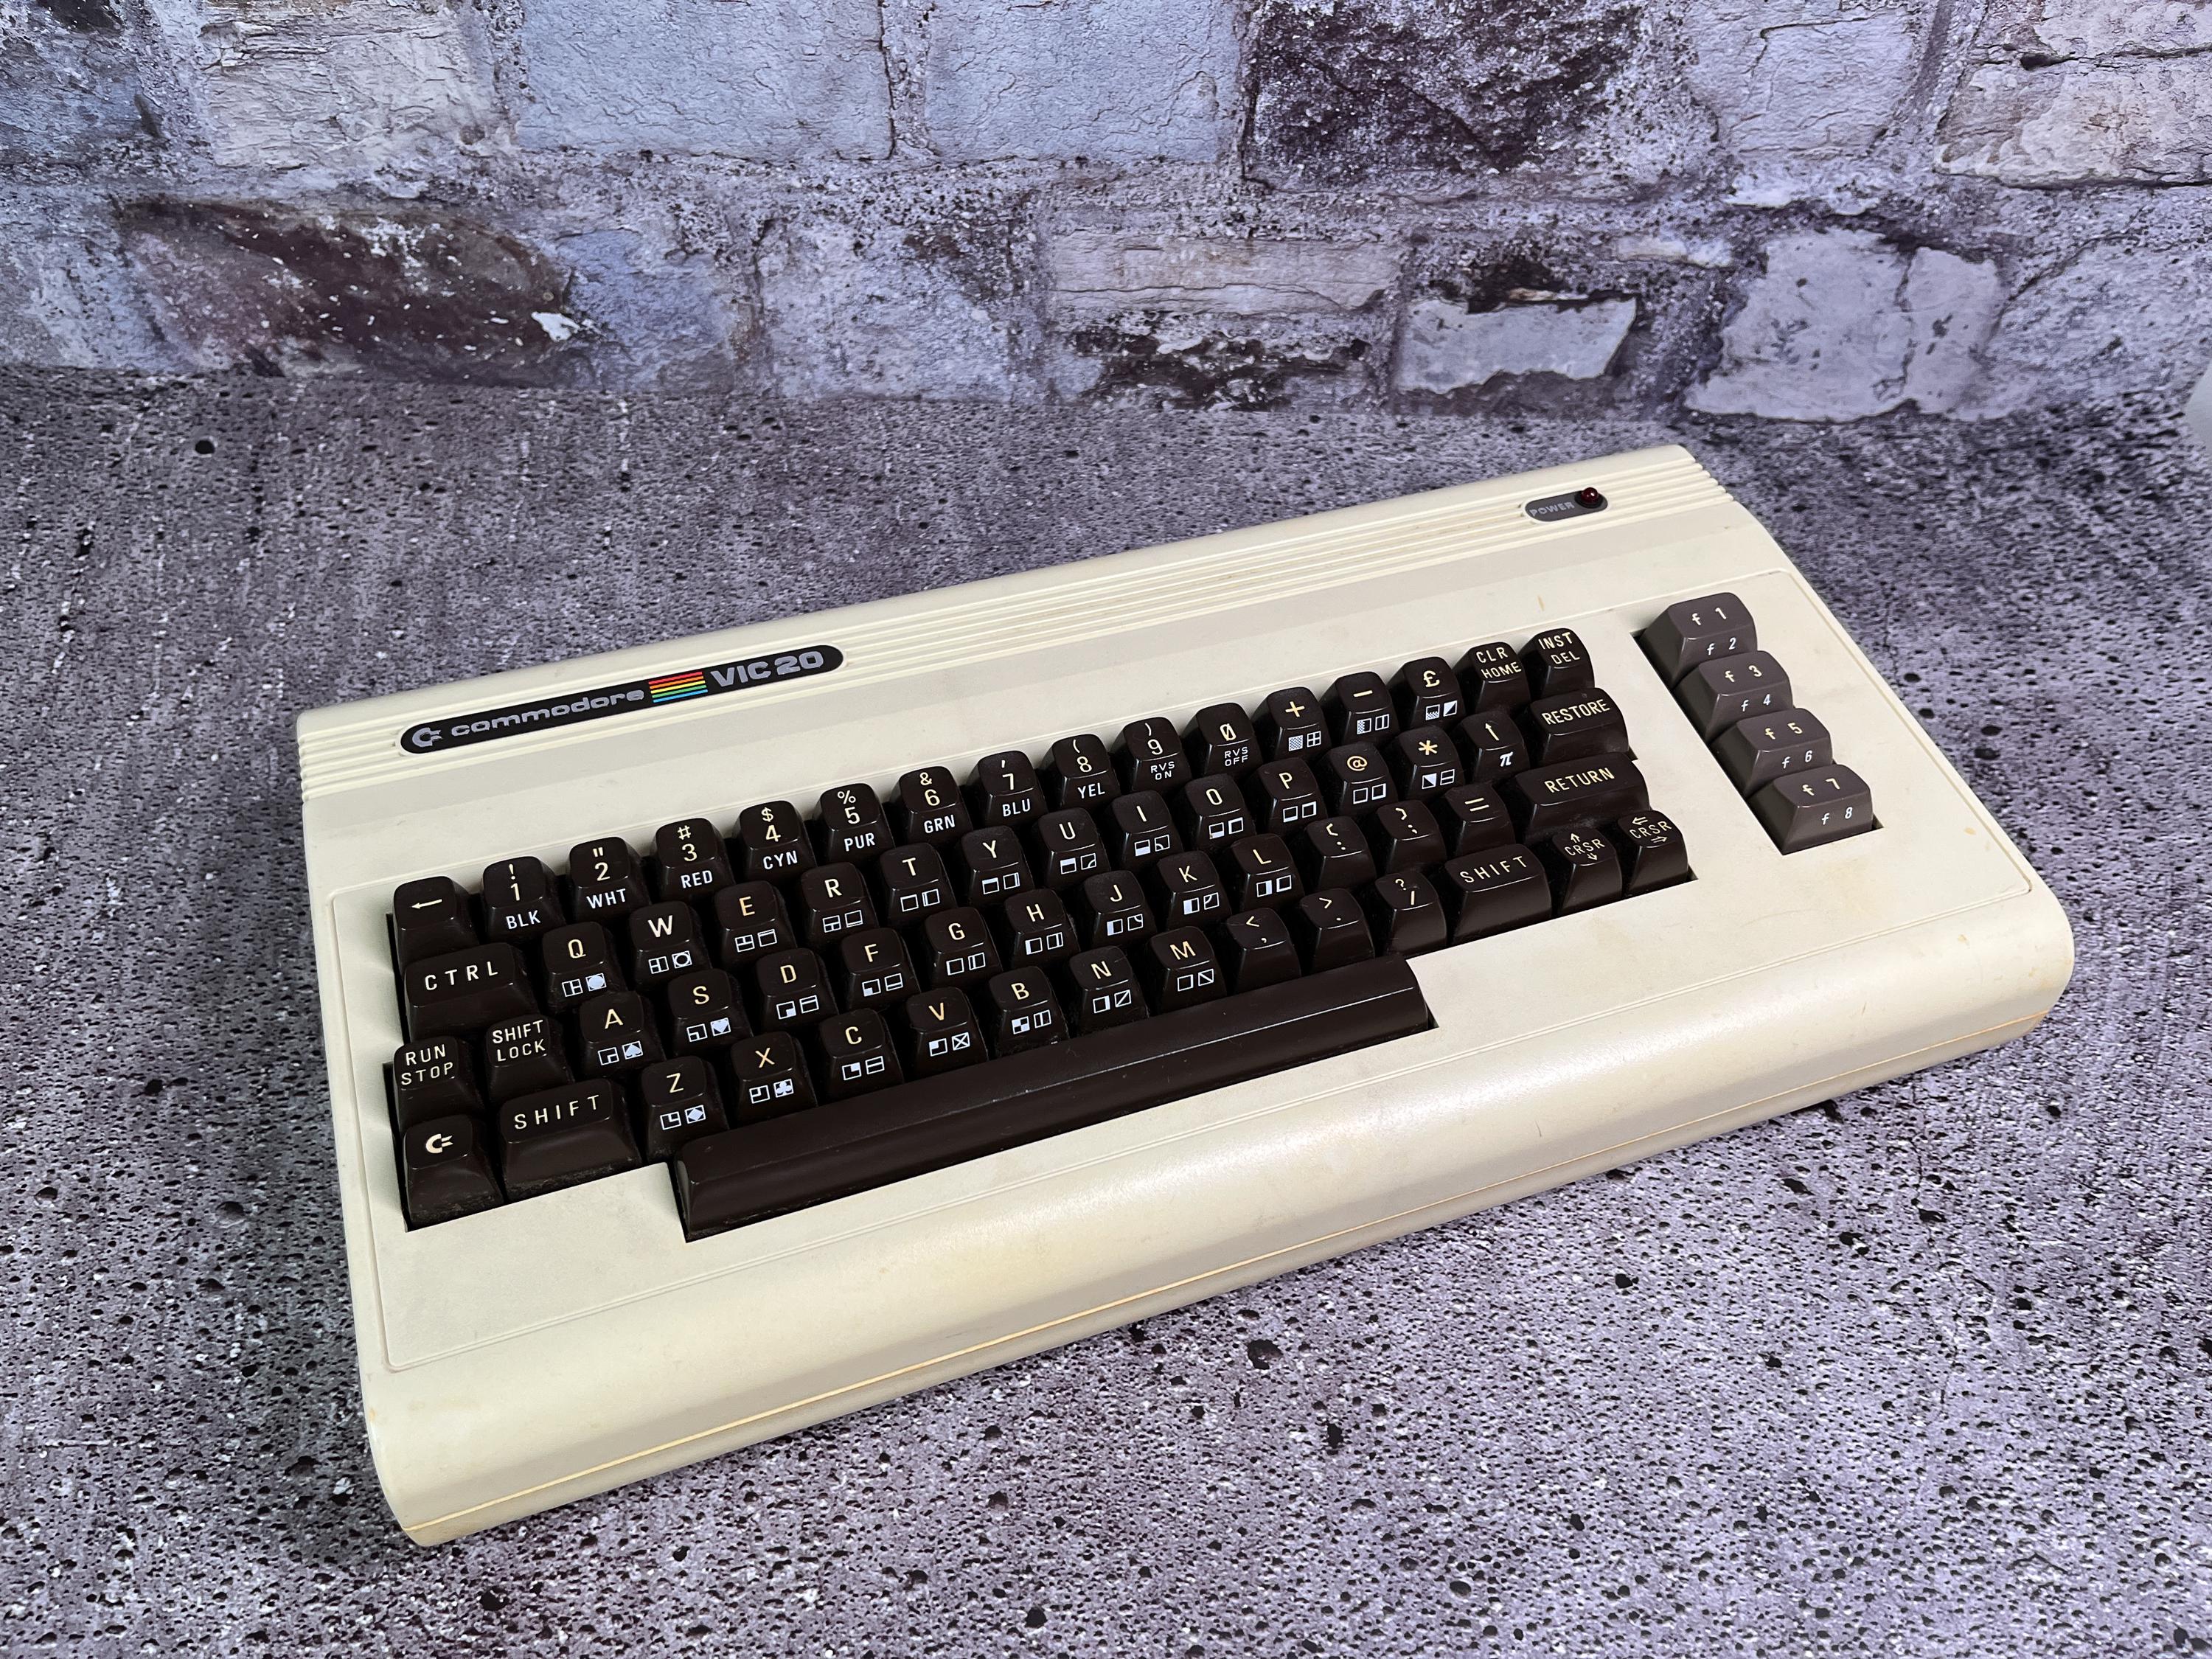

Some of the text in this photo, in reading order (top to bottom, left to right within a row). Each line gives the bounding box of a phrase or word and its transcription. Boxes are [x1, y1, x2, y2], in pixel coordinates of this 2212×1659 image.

[1529, 502, 1576, 517] POWER
[1538, 631, 1573, 650] INST
[1476, 647, 1508, 663] CLR
[1551, 650, 1580, 664] DEL
[1423, 670, 1440, 687] £
[1481, 661, 1522, 679] HOME
[451, 650, 825, 737] commodore VIC 20
[1285, 701, 1305, 717] +
[1541, 699, 1610, 725] RESTORE
[1144, 723, 1152, 737] )
[1073, 739, 1080, 754] (
[1147, 739, 1164, 755] 9
[1224, 746, 1248, 759] RVS
[1077, 756, 1093, 773] 8
[1150, 761, 1175, 773] RVS
[1225, 754, 1248, 767] OFF
[1346, 755, 1368, 771] @
[919, 772, 933, 786] &
[1002, 773, 1014, 790] 7
[1155, 770, 1172, 780] ON
[1279, 772, 1293, 790] P
[1544, 768, 1615, 793] RETURN
[837, 790, 856, 804] %
[925, 789, 940, 806] 6
[1077, 782, 1105, 799] YEL
[1206, 788, 1222, 805] O
[761, 807, 774, 822] $
[844, 806, 860, 824] 5
[1002, 798, 1031, 817] BLU
[677, 825, 692, 840] #
[765, 824, 782, 842] 4
[924, 814, 956, 834] GRN
[1059, 821, 1076, 840] U
[1630, 821, 1672, 838] CRSR
[844, 832, 875, 852] PUR
[982, 840, 997, 858] Y
[1564, 838, 1605, 856] CRSR
[681, 844, 698, 861] 3
[763, 850, 798, 870] CYN
[1253, 849, 1272, 865] L
[509, 863, 515, 880] !
[594, 862, 611, 881] 2
[902, 857, 917, 876] T
[1178, 865, 1197, 883] K
[1458, 856, 1529, 883] SHIFT
[681, 870, 713, 888] RED
[824, 878, 842, 898] R
[1395, 878, 1407, 891] ?
[510, 883, 520, 901] 1
[586, 888, 626, 909] WHT
[1110, 884, 1123, 902] J
[739, 896, 755, 917] E
[1319, 897, 1332, 909] >
[506, 910, 541, 930] BLK
[1026, 903, 1045, 922] H
[647, 915, 673, 938] W
[948, 922, 965, 940] G
[1245, 916, 1259, 928] <
[568, 939, 586, 959] Q
[864, 943, 878, 962] F
[1169, 941, 1196, 960] M
[425, 961, 498, 990] CTRL
[780, 964, 797, 984] D
[1091, 961, 1112, 979] N
[692, 986, 709, 1005] S
[1011, 982, 1029, 1000] B
[605, 1009, 624, 1029] A
[928, 1002, 945, 1020] V
[493, 1019, 543, 1044] SHIFT
[845, 1026, 862, 1045] C
[406, 1044, 445, 1066] RUN
[497, 1038, 547, 1062] LOCK
[755, 1047, 775, 1068] X
[401, 1062, 455, 1085] STOP
[666, 1072, 684, 1093] Z
[514, 1094, 599, 1130] SHIFT
